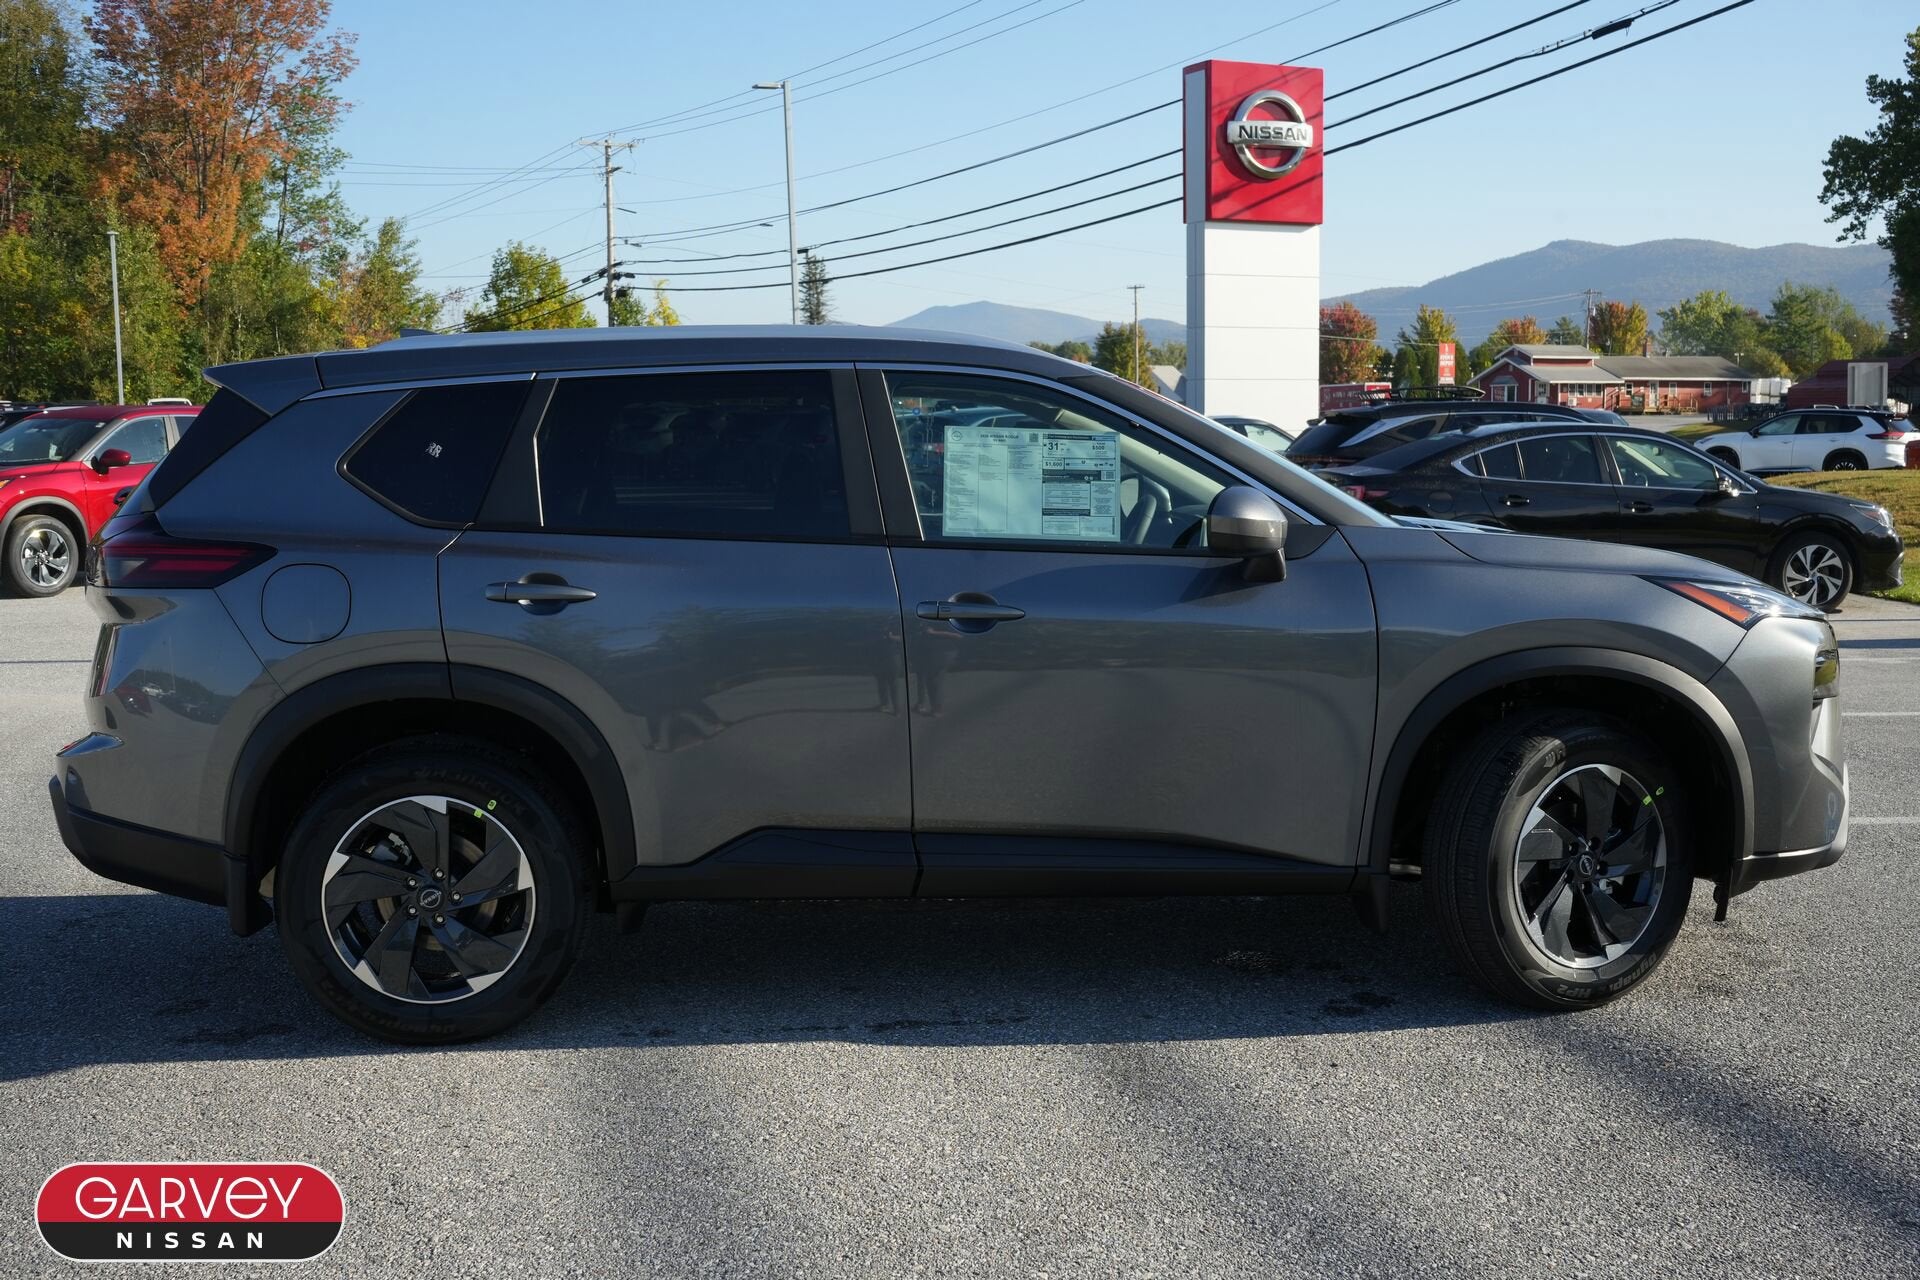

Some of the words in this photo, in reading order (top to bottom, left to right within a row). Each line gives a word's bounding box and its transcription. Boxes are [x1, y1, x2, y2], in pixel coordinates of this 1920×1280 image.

[1238, 125, 1307, 141] NISSAN
[1048, 442, 1059, 451] 31
[1557, 984, 1592, 998] HP2
